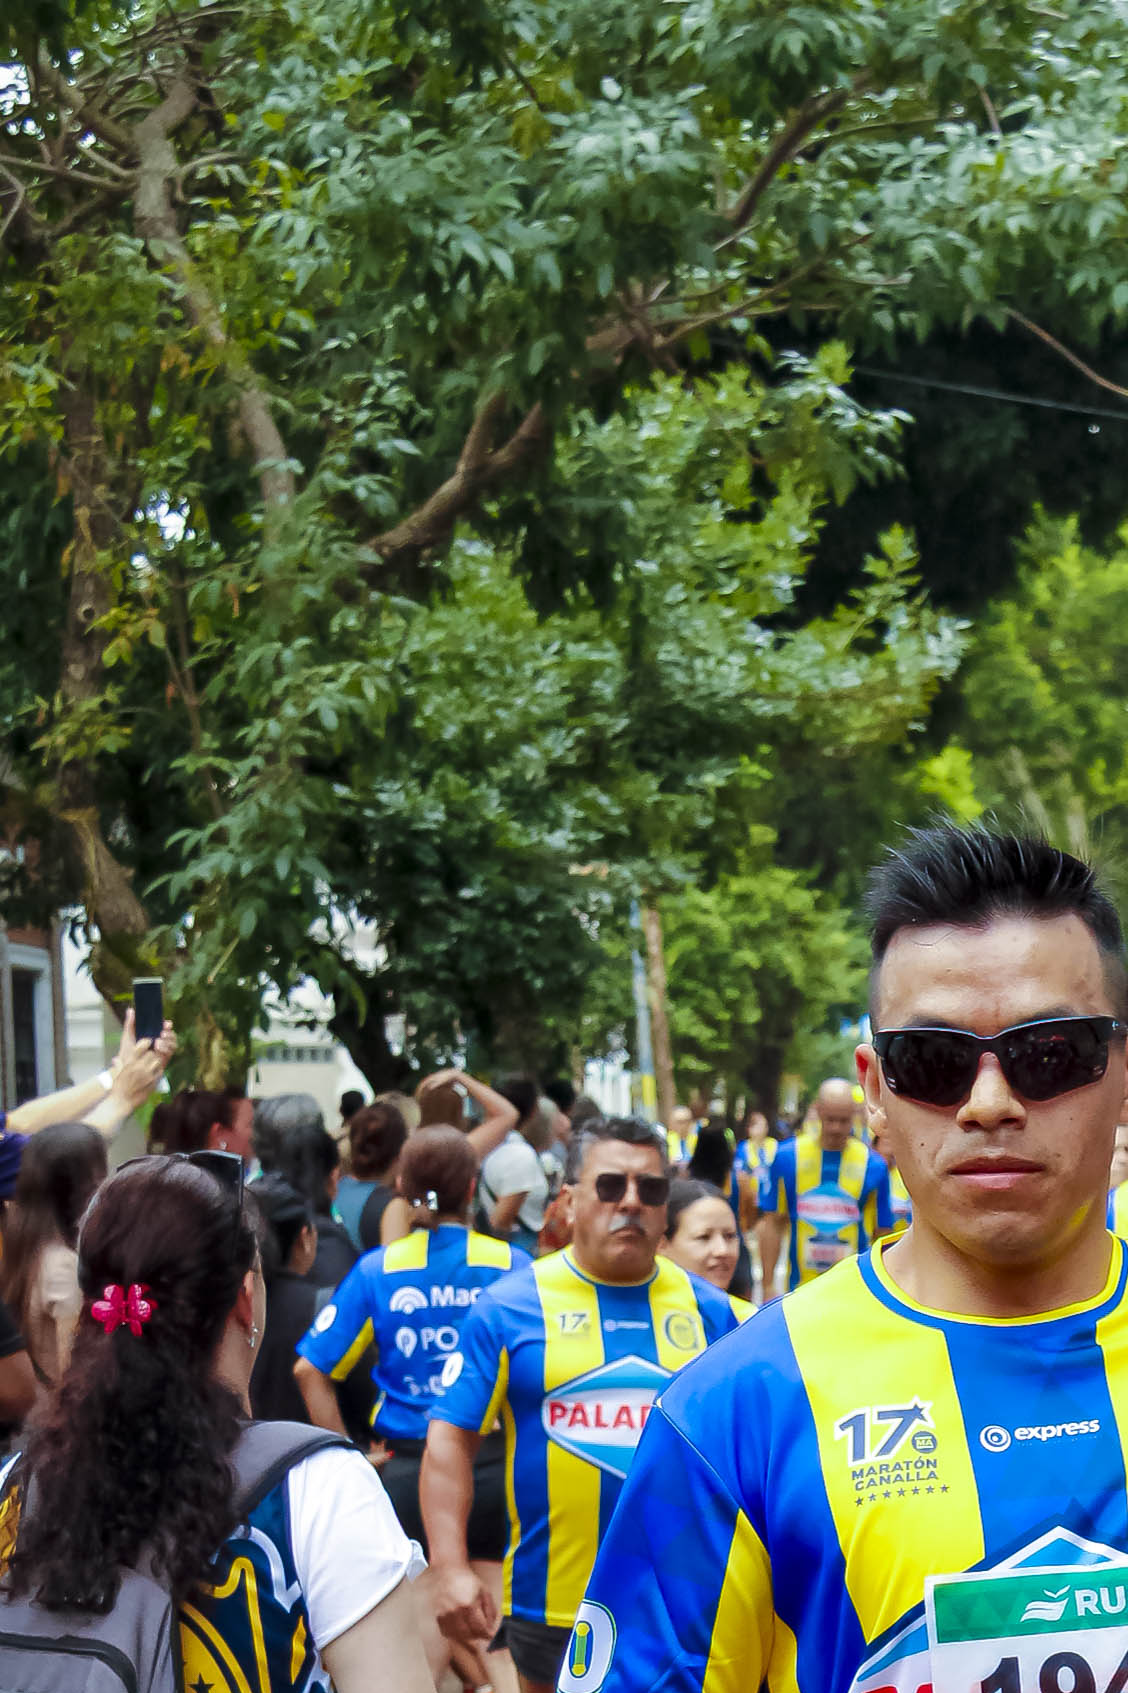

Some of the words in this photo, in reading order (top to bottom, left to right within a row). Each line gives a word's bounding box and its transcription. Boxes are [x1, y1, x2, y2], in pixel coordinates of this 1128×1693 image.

[837, 1401, 929, 1465] 17
[1013, 1418, 1101, 1442] express
[851, 1457, 938, 1481] MARATÓN
[854, 1470, 939, 1491] CANALLA
